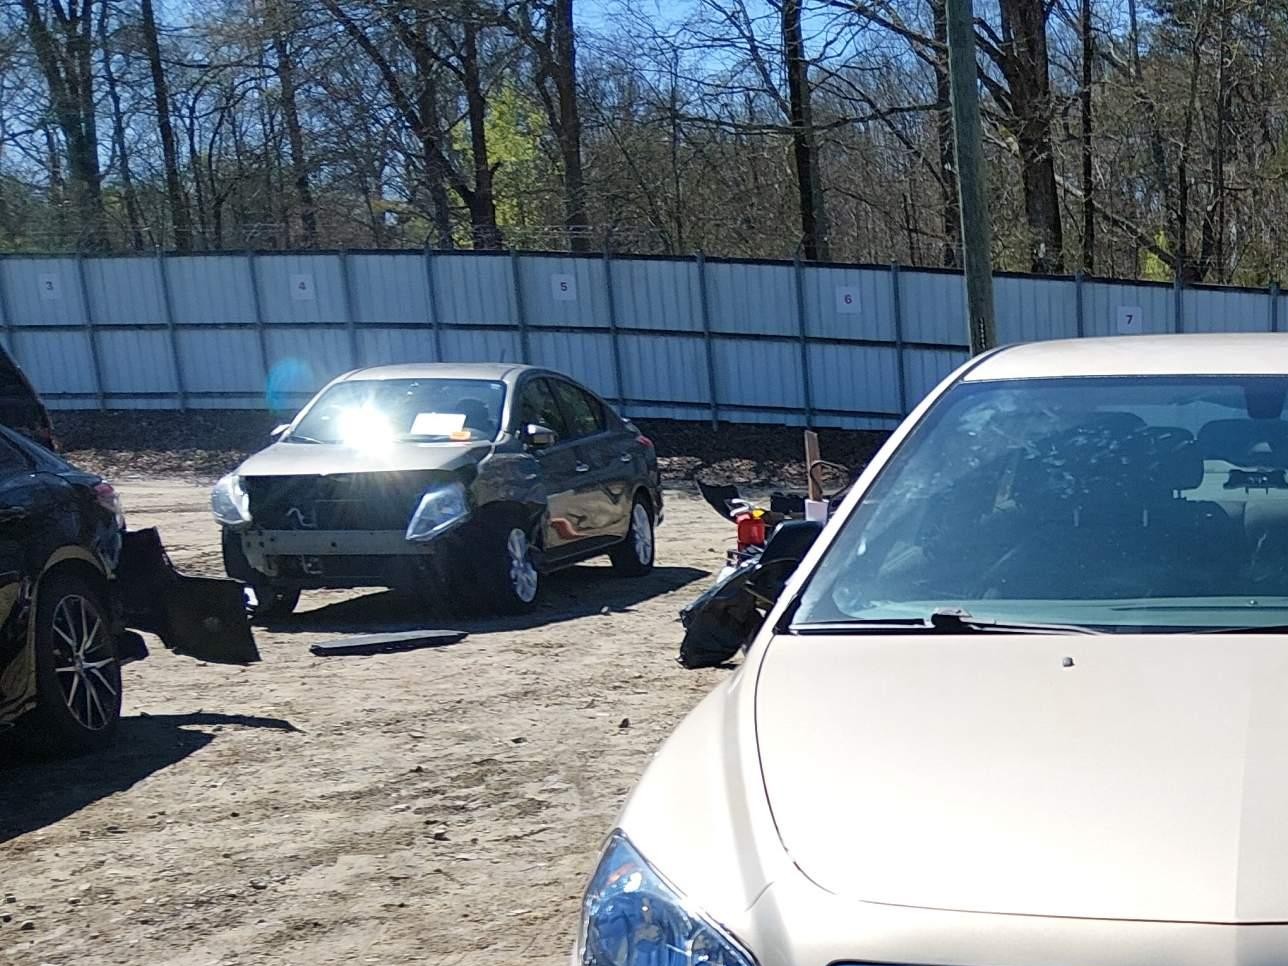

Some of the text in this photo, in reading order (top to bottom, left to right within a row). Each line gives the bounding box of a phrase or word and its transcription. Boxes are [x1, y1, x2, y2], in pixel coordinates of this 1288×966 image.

[45, 281, 54, 291] 3
[298, 281, 307, 291] 4
[560, 281, 568, 291] 5
[844, 294, 853, 304] 6
[1125, 315, 1133, 325] 7
